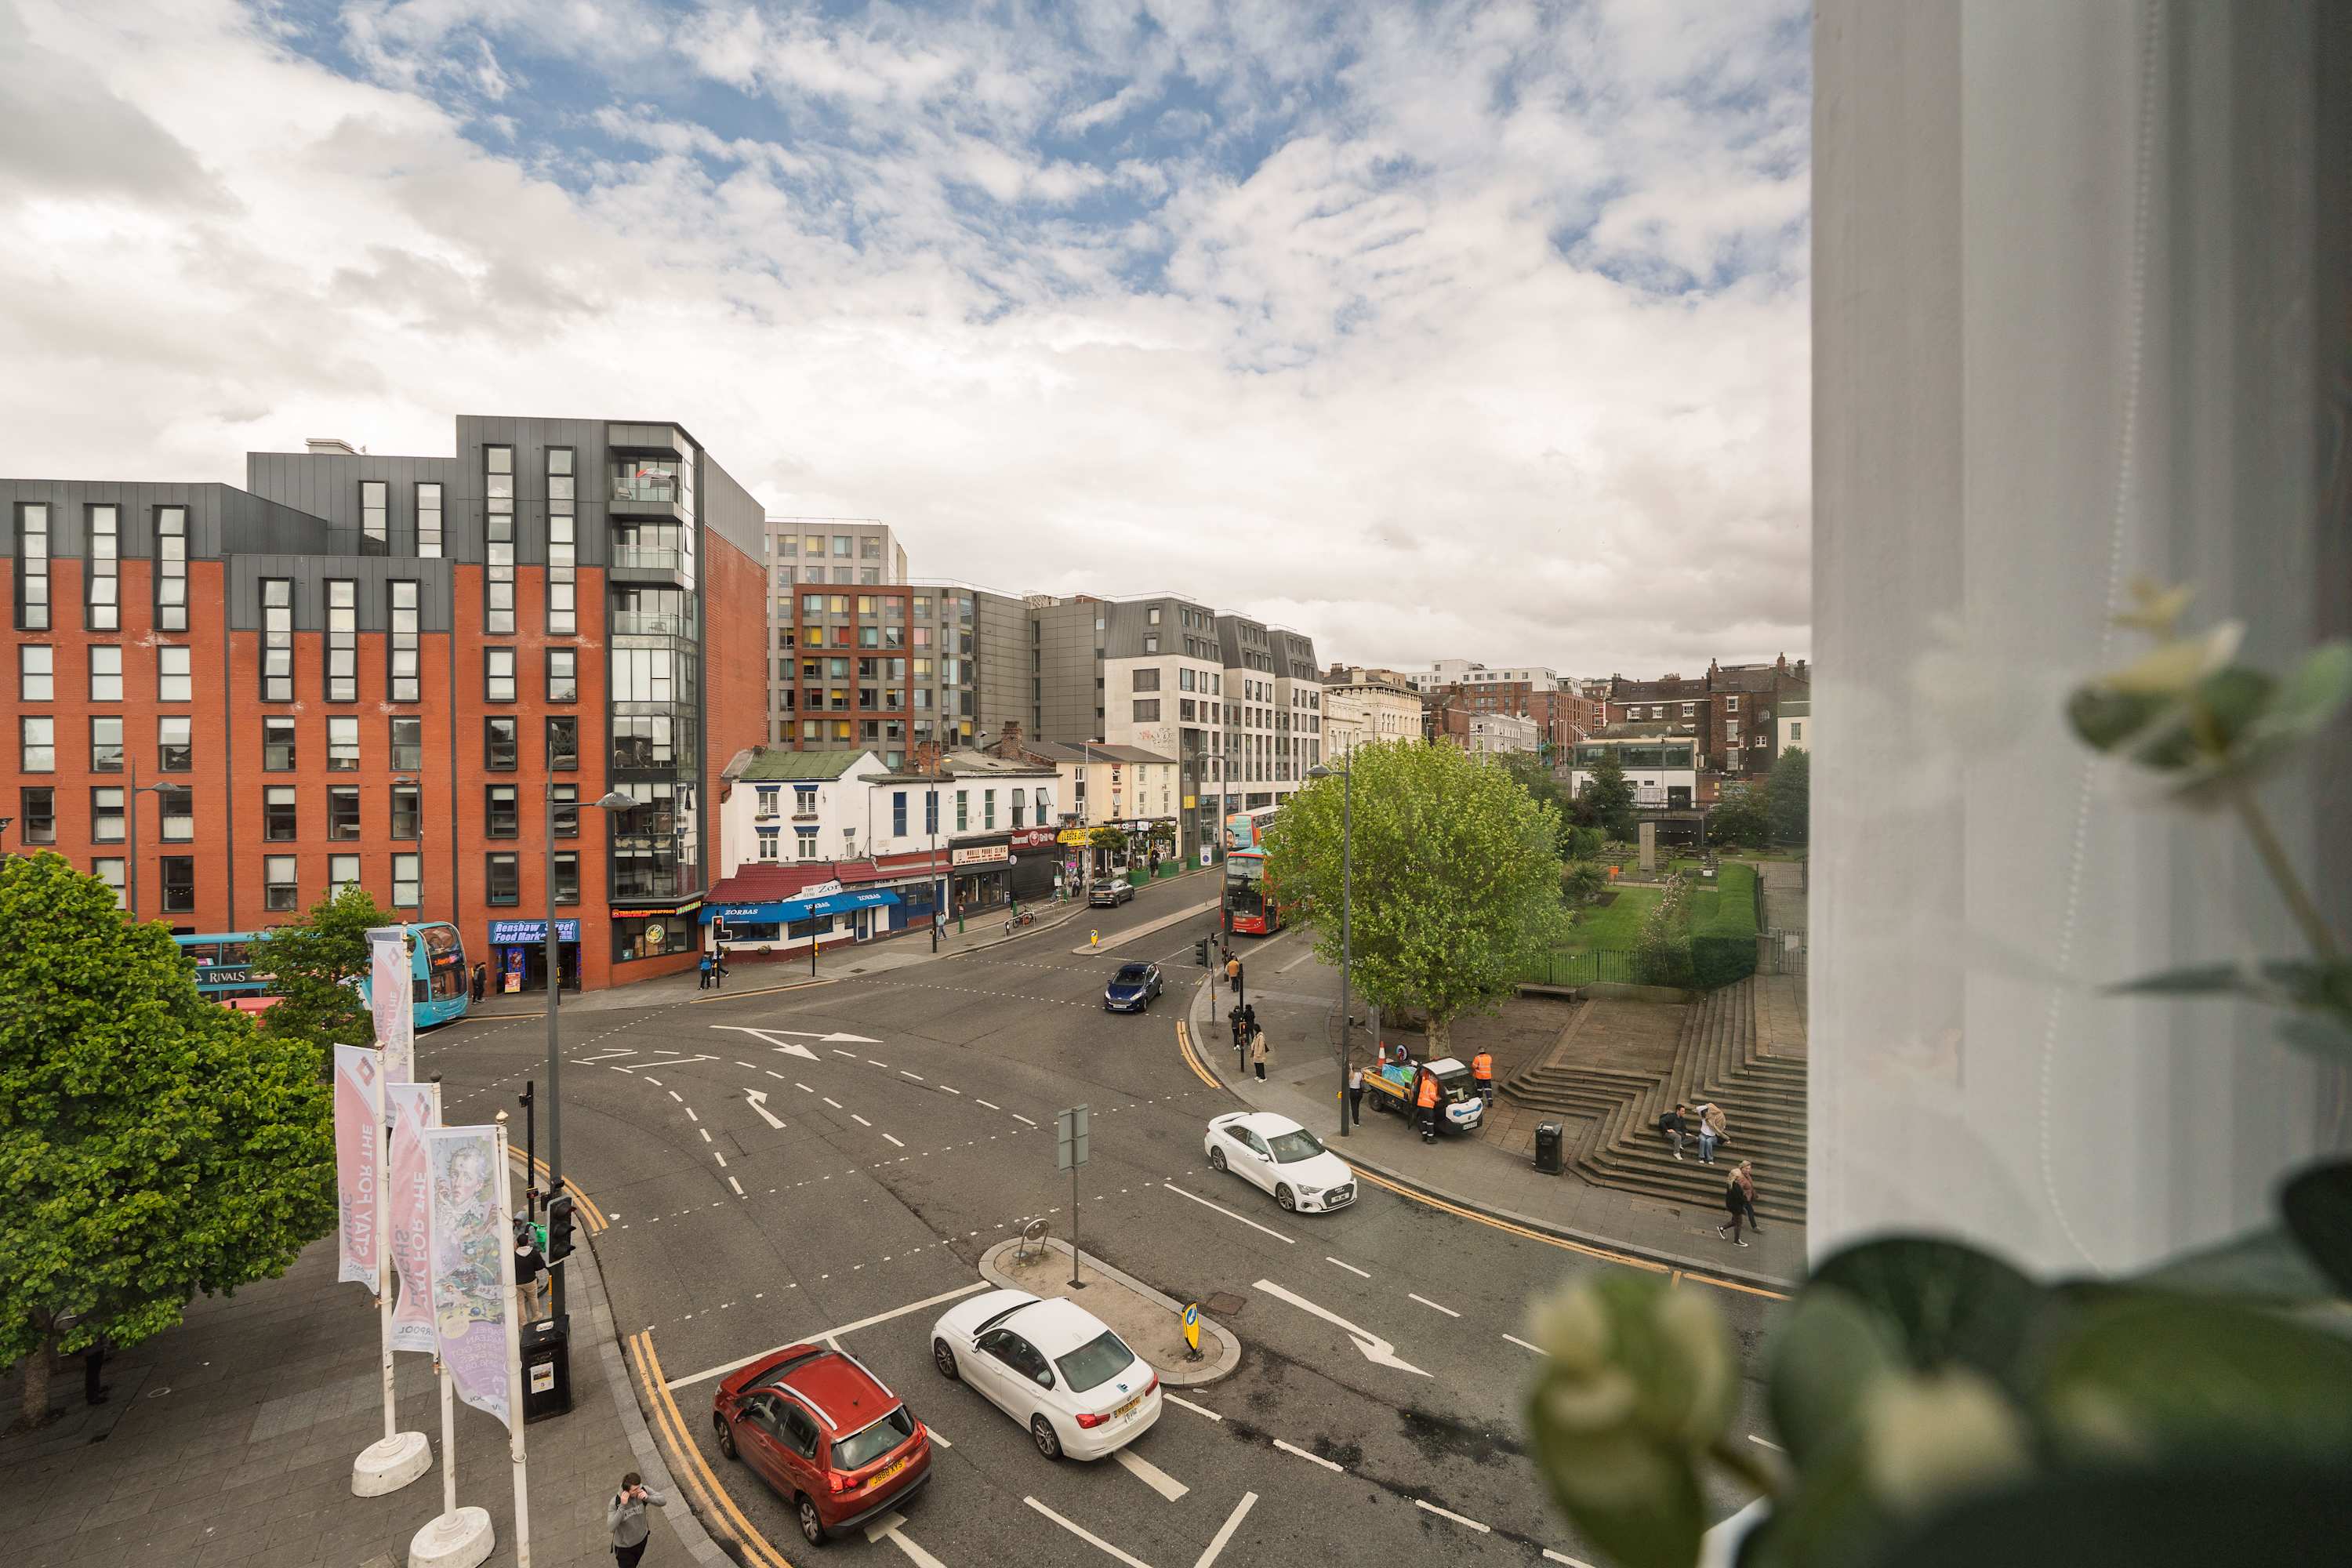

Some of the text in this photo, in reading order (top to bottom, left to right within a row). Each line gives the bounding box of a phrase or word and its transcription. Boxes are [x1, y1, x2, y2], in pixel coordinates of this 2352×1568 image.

[856, 893, 881, 902] ZORBAS
[724, 908, 759, 916] ZORBAS
[495, 923, 541, 933] Renshaw
[495, 931, 517, 942] Food
[517, 931, 546, 942] Marke
[209, 971, 246, 983] RIVALS
